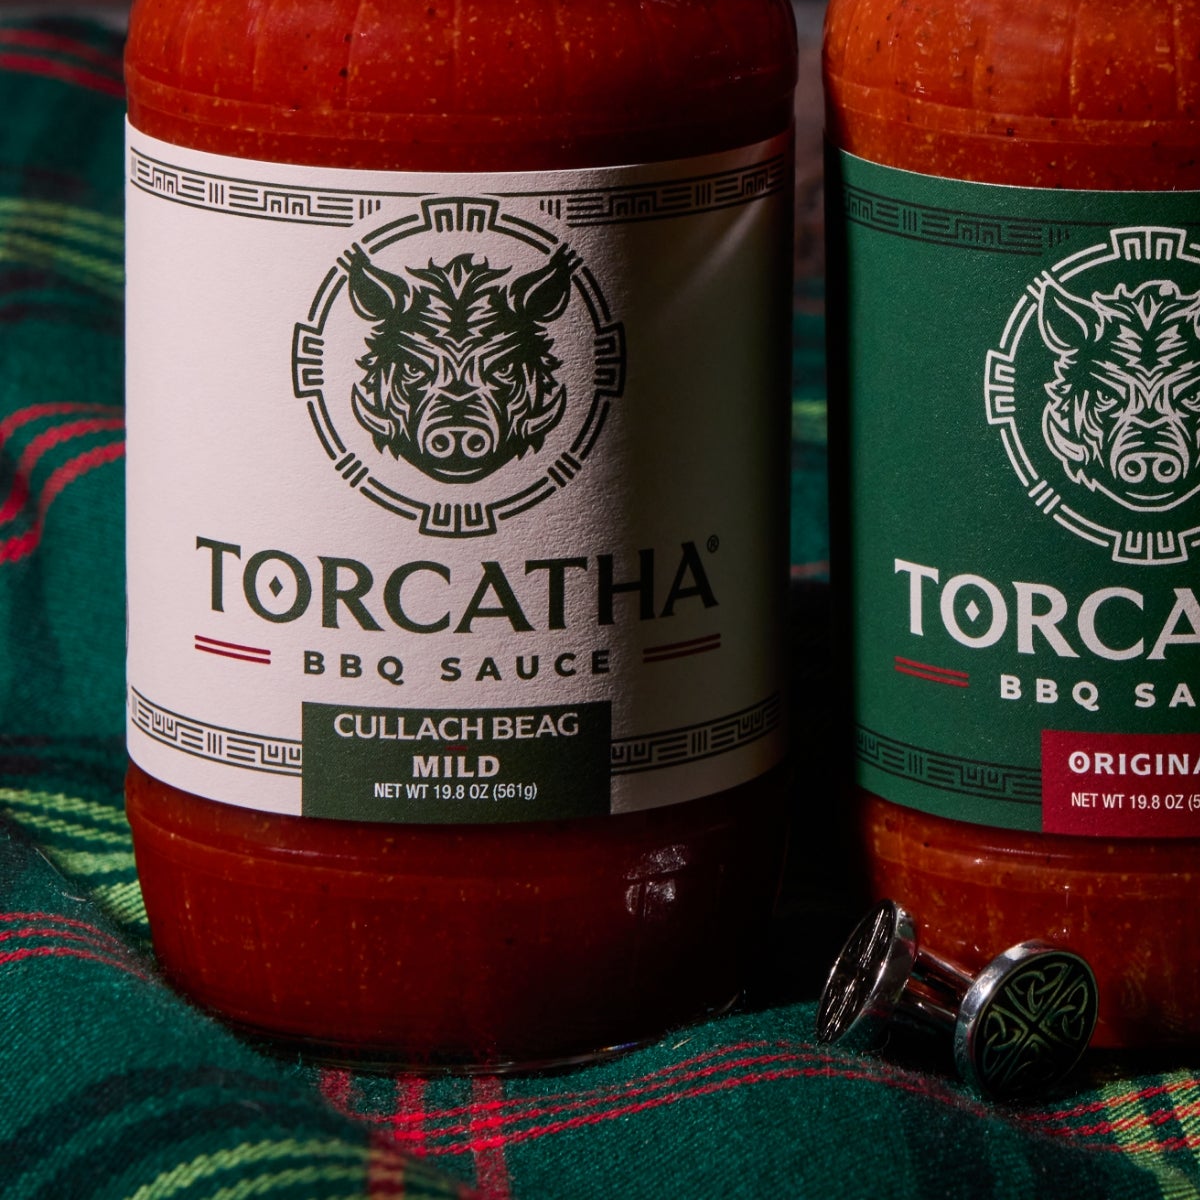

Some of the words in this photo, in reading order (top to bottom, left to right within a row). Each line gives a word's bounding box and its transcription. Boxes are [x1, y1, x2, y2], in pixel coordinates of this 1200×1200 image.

[303, 649, 405, 685] BBQ
[440, 648, 612, 683] SAUCE
[1000, 673, 1101, 712] BBQ
[333, 713, 484, 741] CULLACH
[492, 712, 579, 740] BEAG
[412, 755, 501, 779] MILD
[374, 782, 402, 799] NET
[406, 784, 429, 799] WT
[433, 784, 465, 800] 19.8
[469, 784, 489, 800] OZ
[493, 782, 538, 801] (561g)
[1071, 792, 1099, 808] NET
[1102, 793, 1125, 809] WT
[1129, 794, 1161, 810] 19.8
[1165, 794, 1184, 810] OZ
